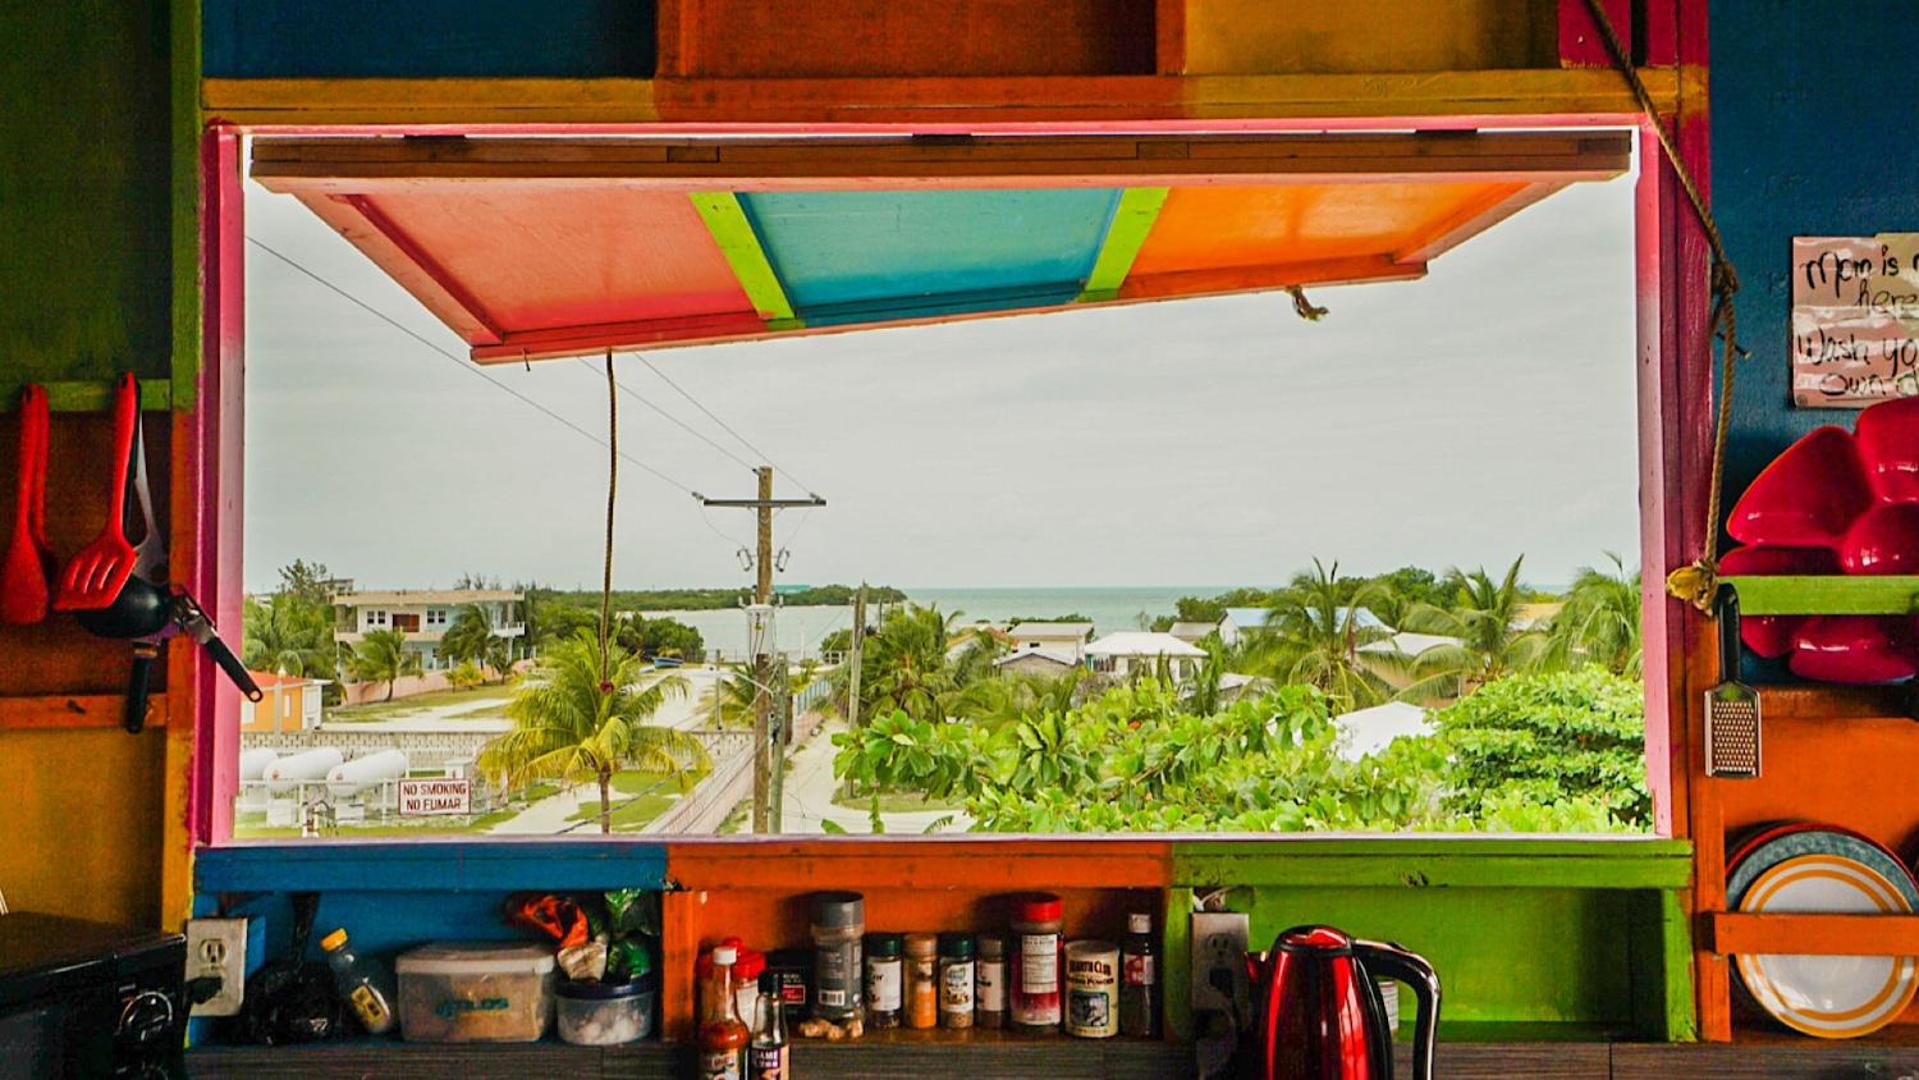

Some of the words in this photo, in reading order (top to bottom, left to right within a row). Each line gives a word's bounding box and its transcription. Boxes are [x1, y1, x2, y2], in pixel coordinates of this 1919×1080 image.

[1881, 244, 1899, 276] is
[1798, 328, 1871, 366] Wash
[403, 784, 418, 796] NO
[420, 783, 467, 796] SMOKING
[407, 799, 420, 811] NO
[424, 798, 461, 811] FUMAR
